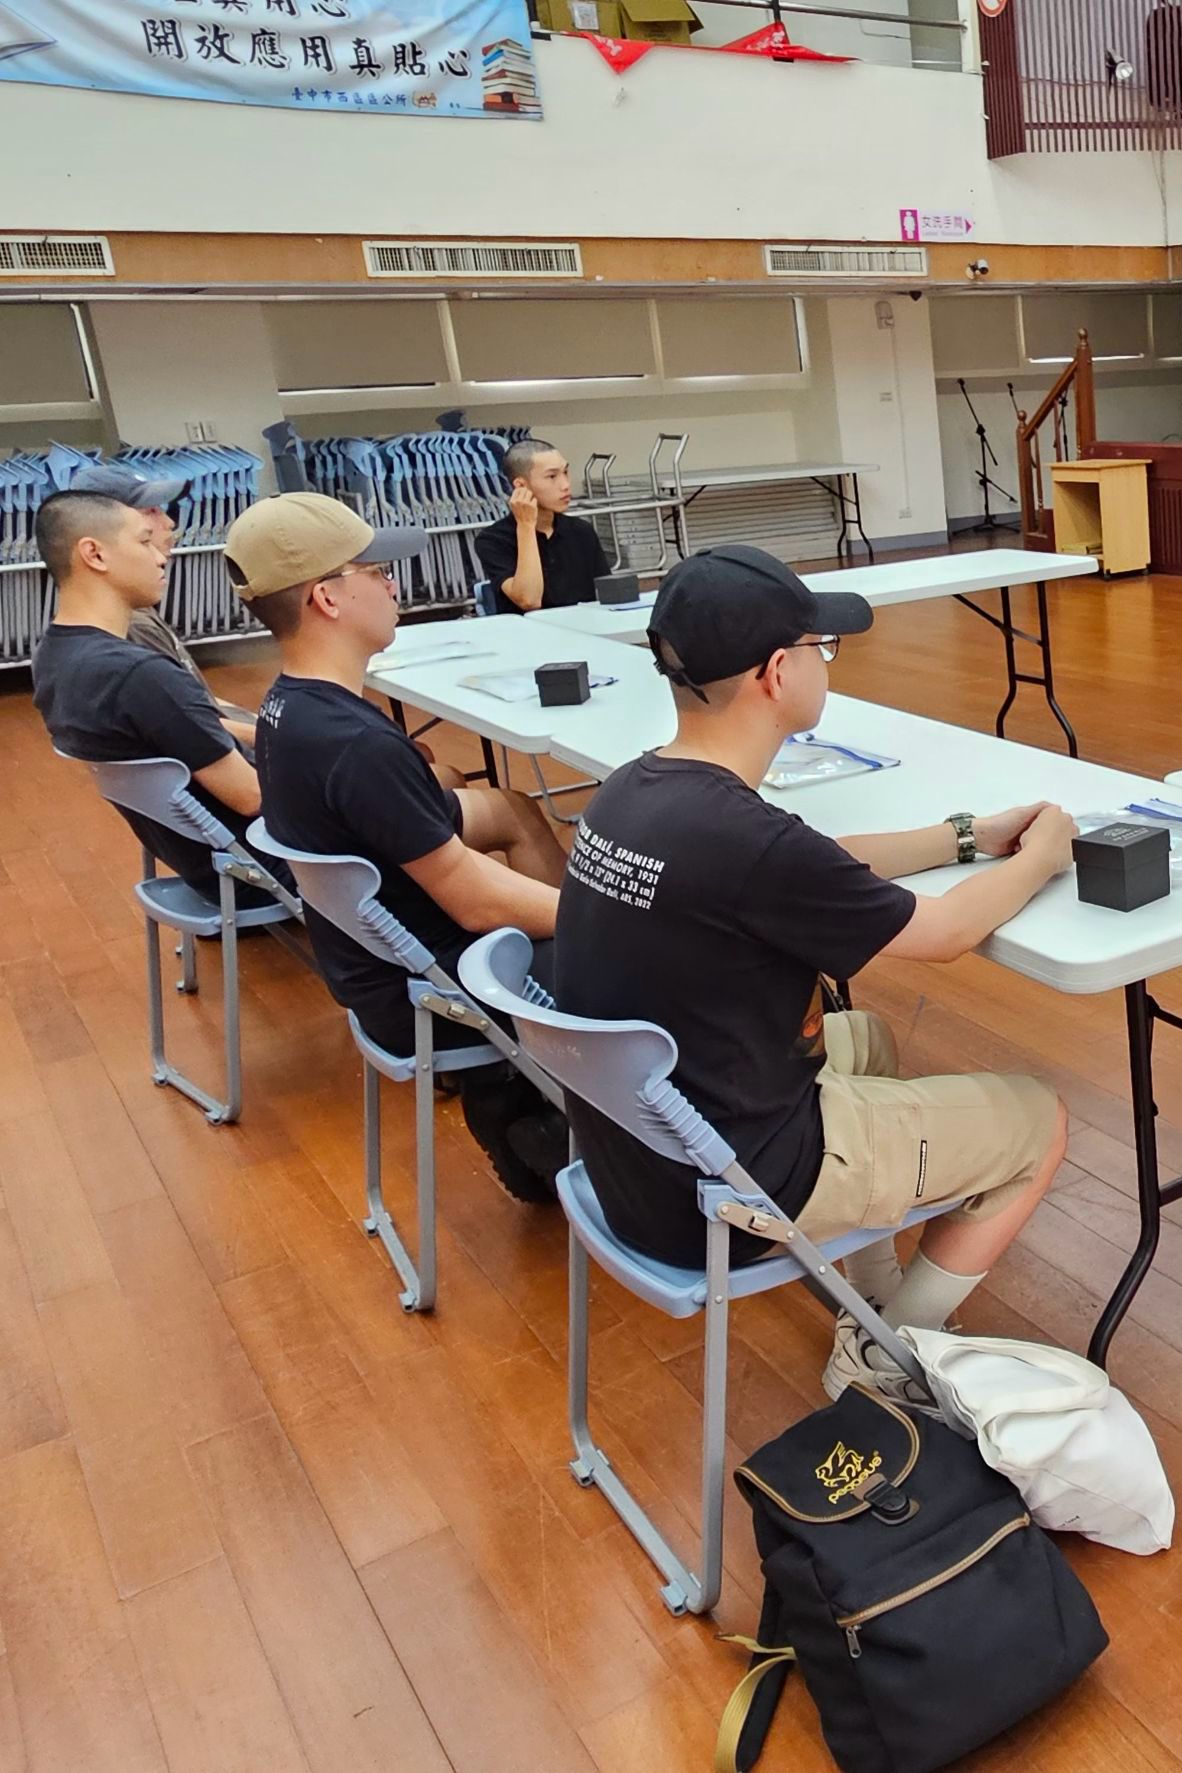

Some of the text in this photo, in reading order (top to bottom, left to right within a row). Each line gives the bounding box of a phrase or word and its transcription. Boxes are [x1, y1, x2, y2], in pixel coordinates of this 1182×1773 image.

[141, 19, 470, 78] 開放應用真貼心
[590, 850, 603, 862] OF
[600, 856, 634, 878] MEMORY,
[638, 869, 659, 885] 1931
[614, 847, 665, 873] SPANISH
[627, 880, 639, 893] 33
[639, 886, 656, 901] cm)
[634, 896, 651, 910] 2022
